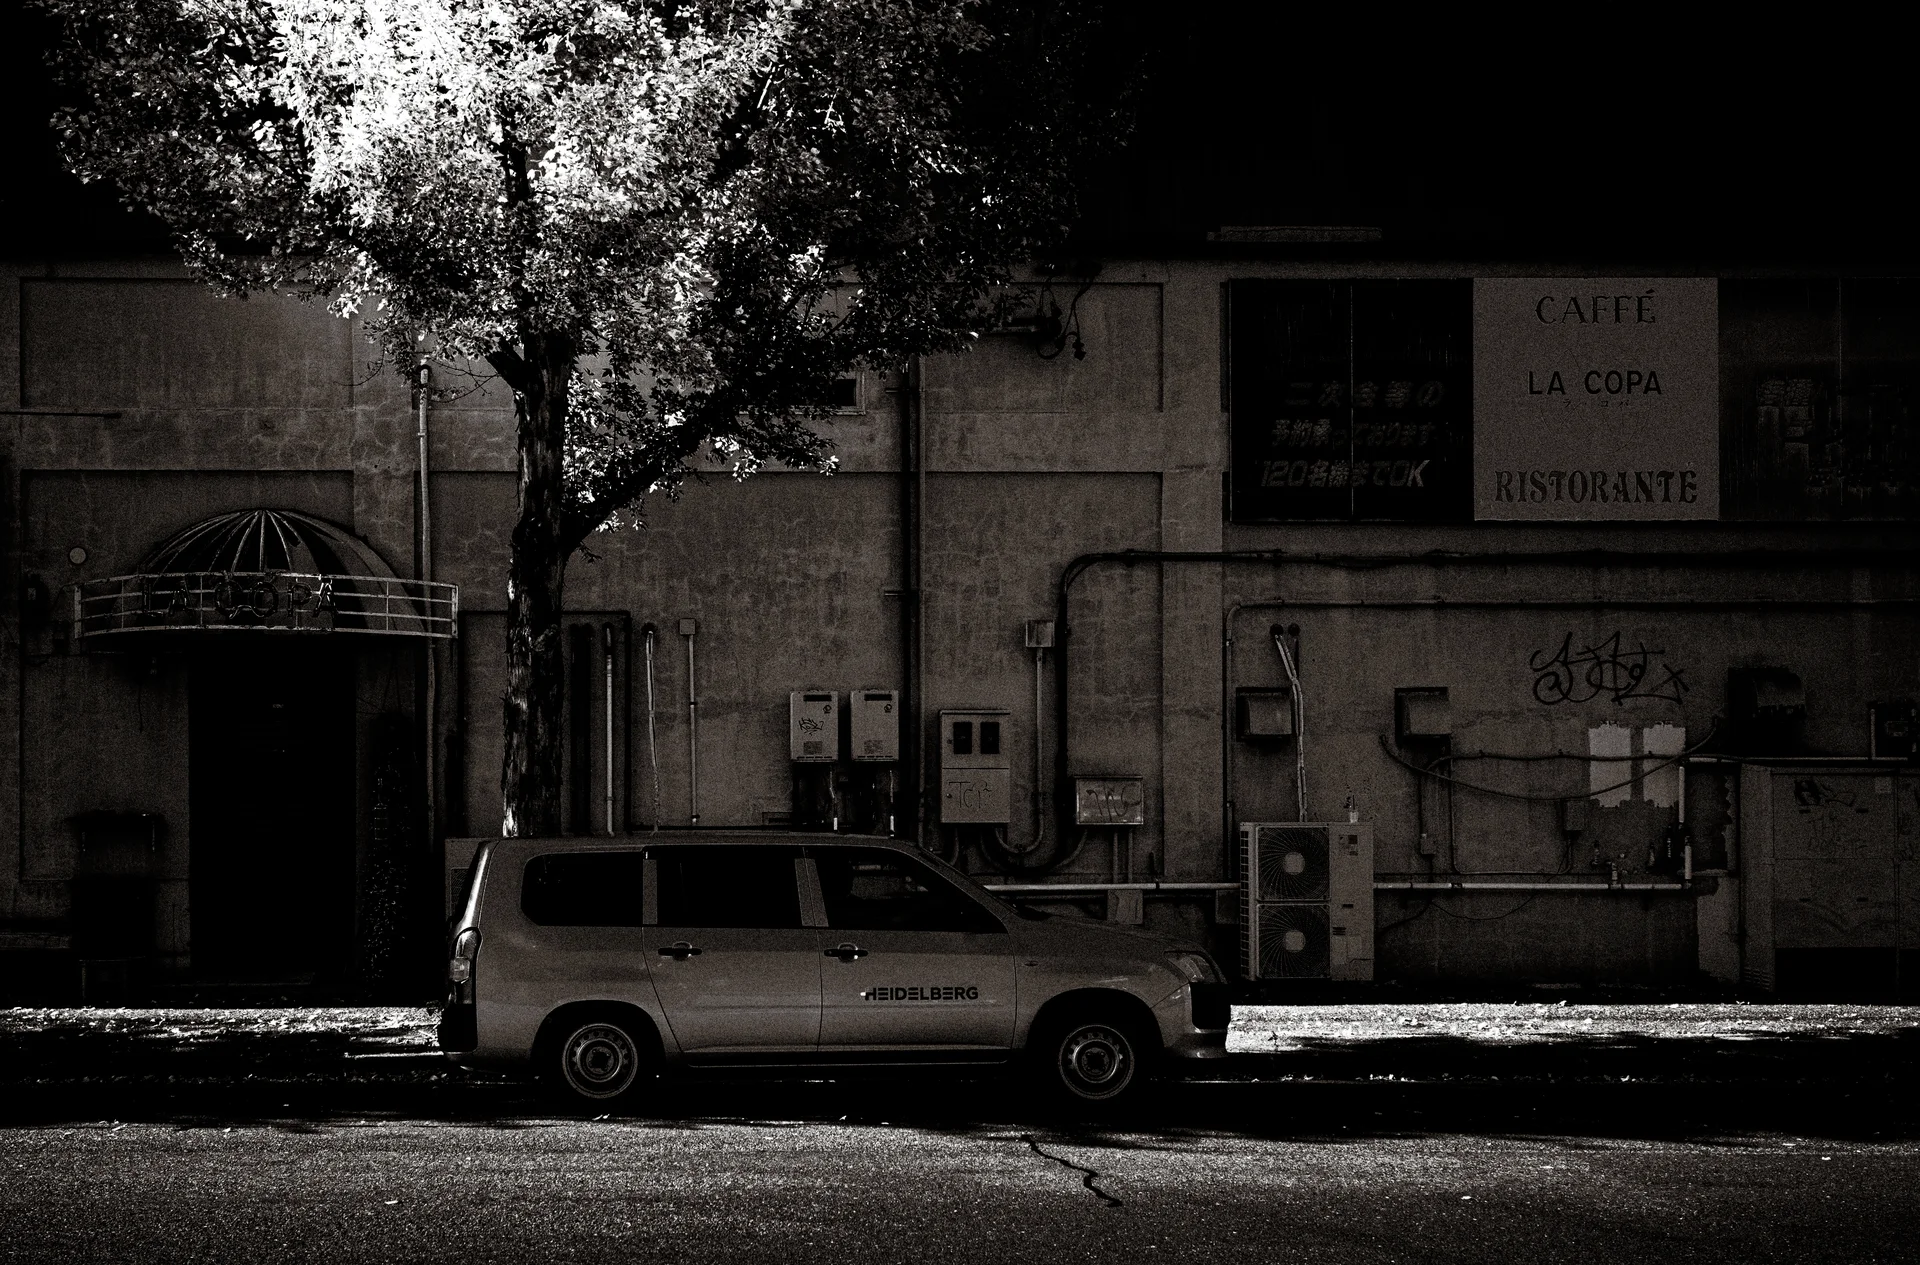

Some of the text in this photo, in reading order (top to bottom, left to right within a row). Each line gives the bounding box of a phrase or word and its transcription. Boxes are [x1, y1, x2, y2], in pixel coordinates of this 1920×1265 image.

[1534, 289, 1656, 324] CAFFÉ
[1529, 370, 1662, 395] LA COPA
[1494, 469, 1698, 504] RISTORANTE
[143, 578, 338, 619] LA COPA
[864, 986, 979, 1001] HEIDELBERG
